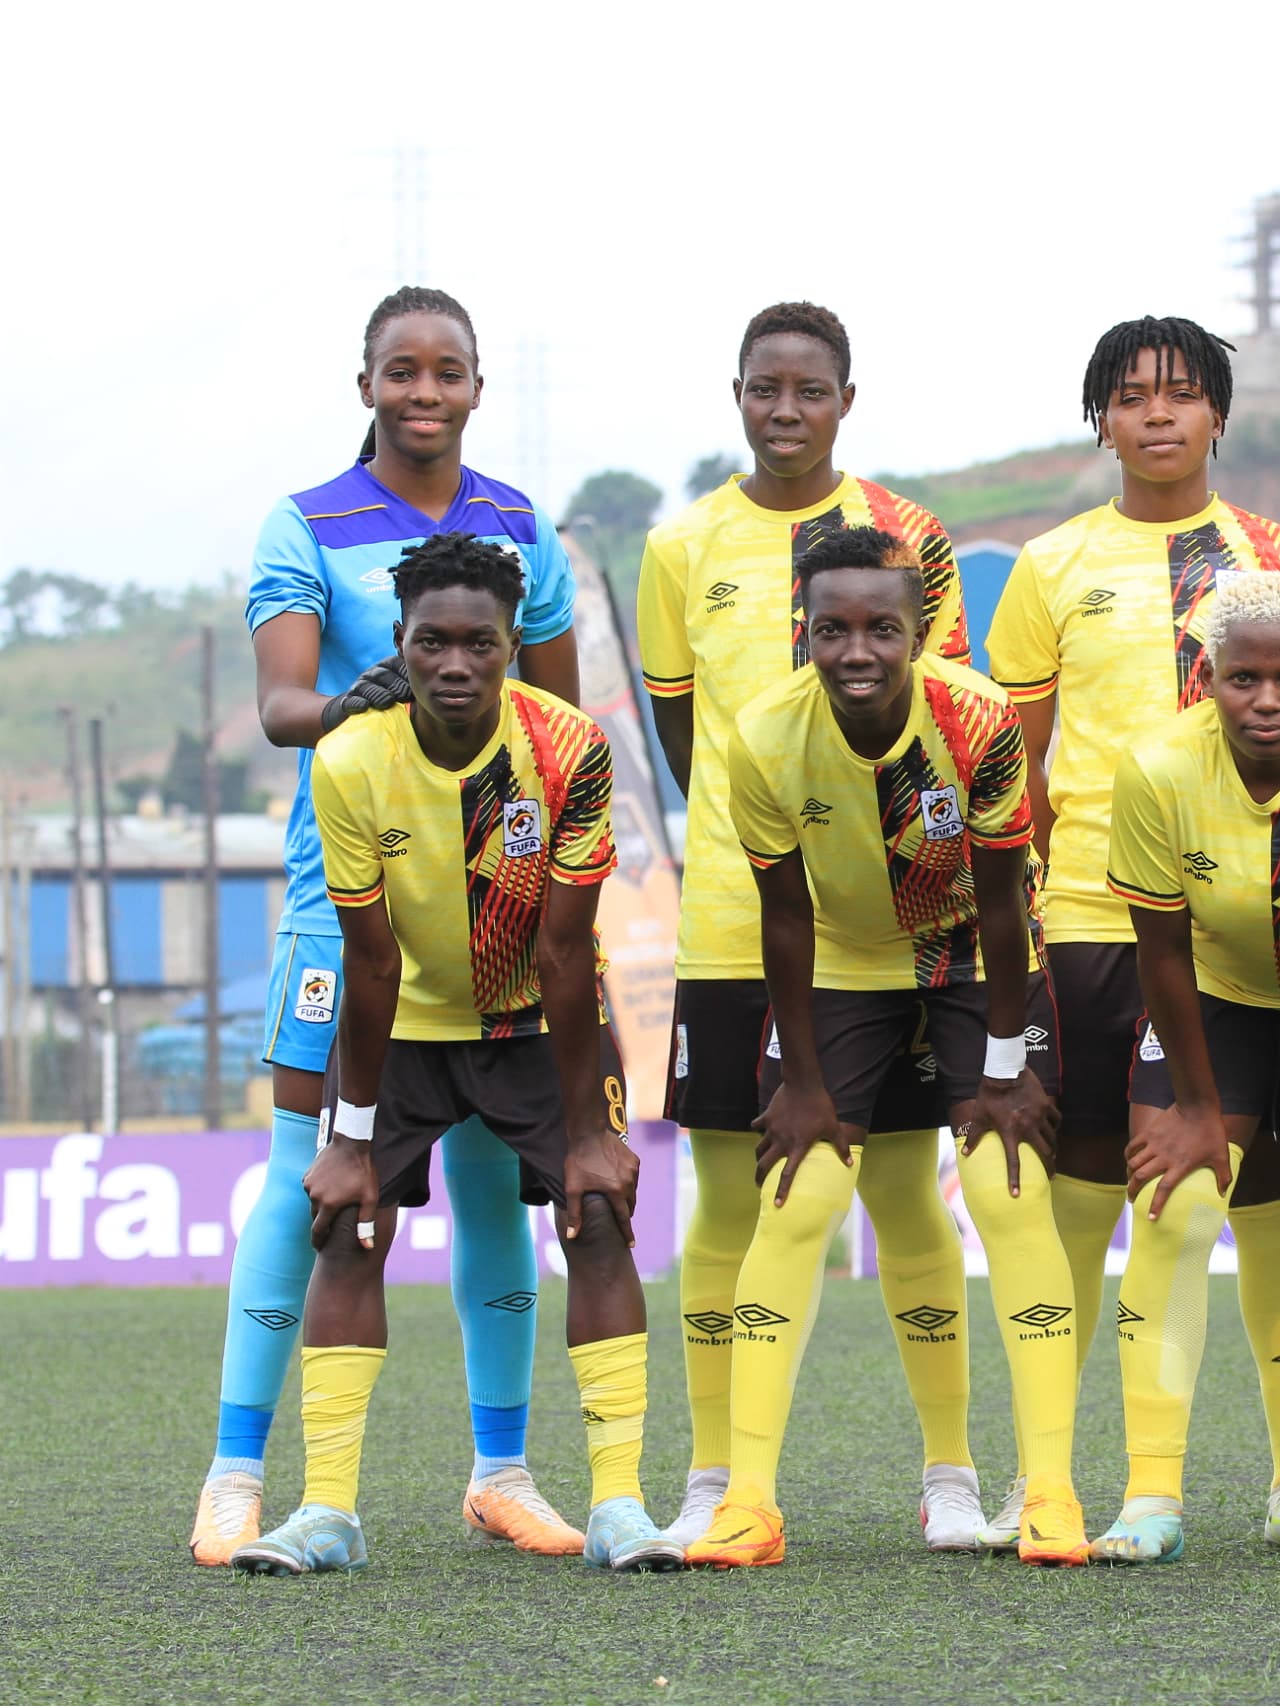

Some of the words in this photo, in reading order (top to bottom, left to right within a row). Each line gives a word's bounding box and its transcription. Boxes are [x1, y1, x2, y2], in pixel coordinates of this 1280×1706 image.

[706, 600, 736, 614] umbro
[1081, 606, 1114, 618] umbro
[932, 824, 959, 839] FUFA
[510, 840, 537, 854] FUFA
[380, 848, 408, 859] mbro
[300, 1008, 325, 1019] FUFA
[1027, 1043, 1049, 1053] mbro
[1141, 1048, 1161, 1058] FUFA
[604, 1075, 627, 1133] 8
[907, 1331, 956, 1343] umbro
[1019, 1327, 1072, 1341] umbro
